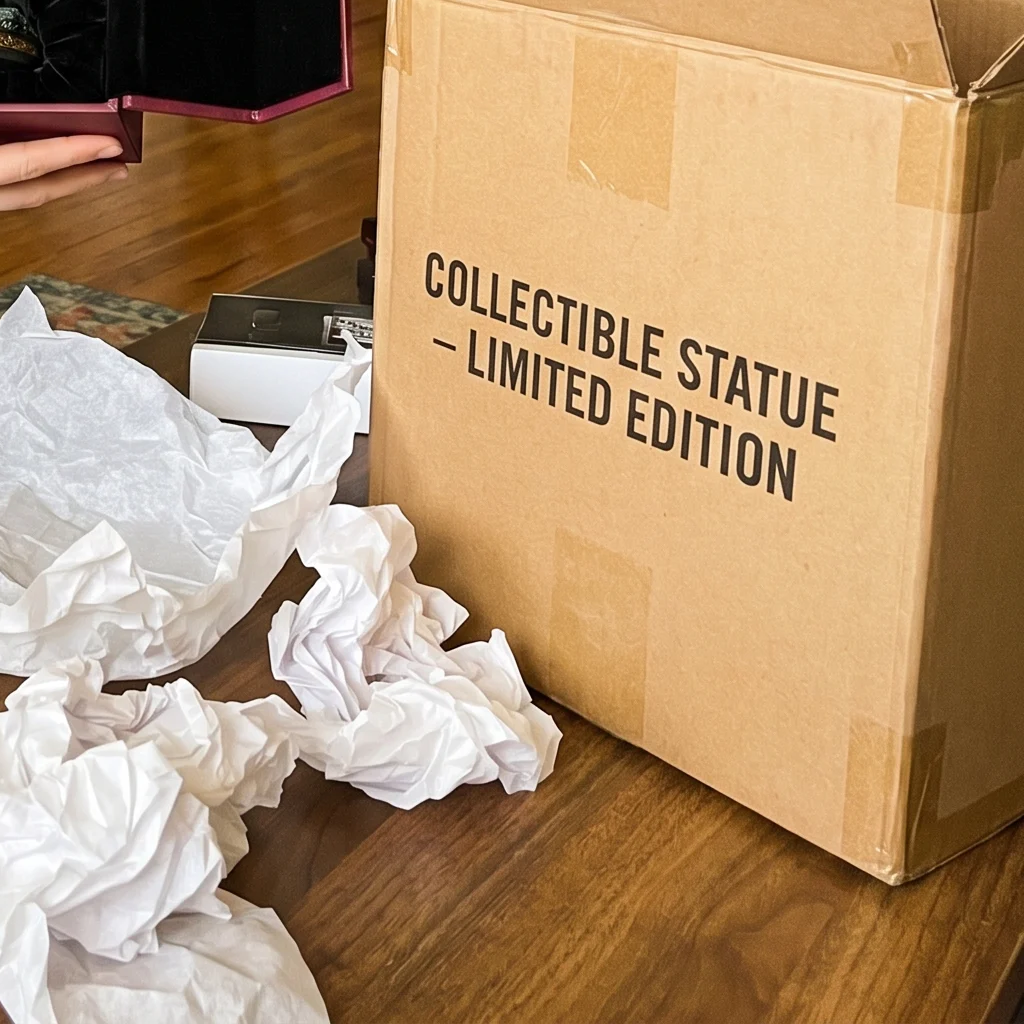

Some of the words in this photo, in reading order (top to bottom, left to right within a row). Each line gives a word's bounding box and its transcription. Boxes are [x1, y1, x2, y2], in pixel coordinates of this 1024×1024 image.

[425, 252, 664, 380] COLLECTIBLE
[677, 338, 839, 443] STATUE
[467, 328, 612, 426] LIMITED
[626, 388, 797, 502] EDITION
